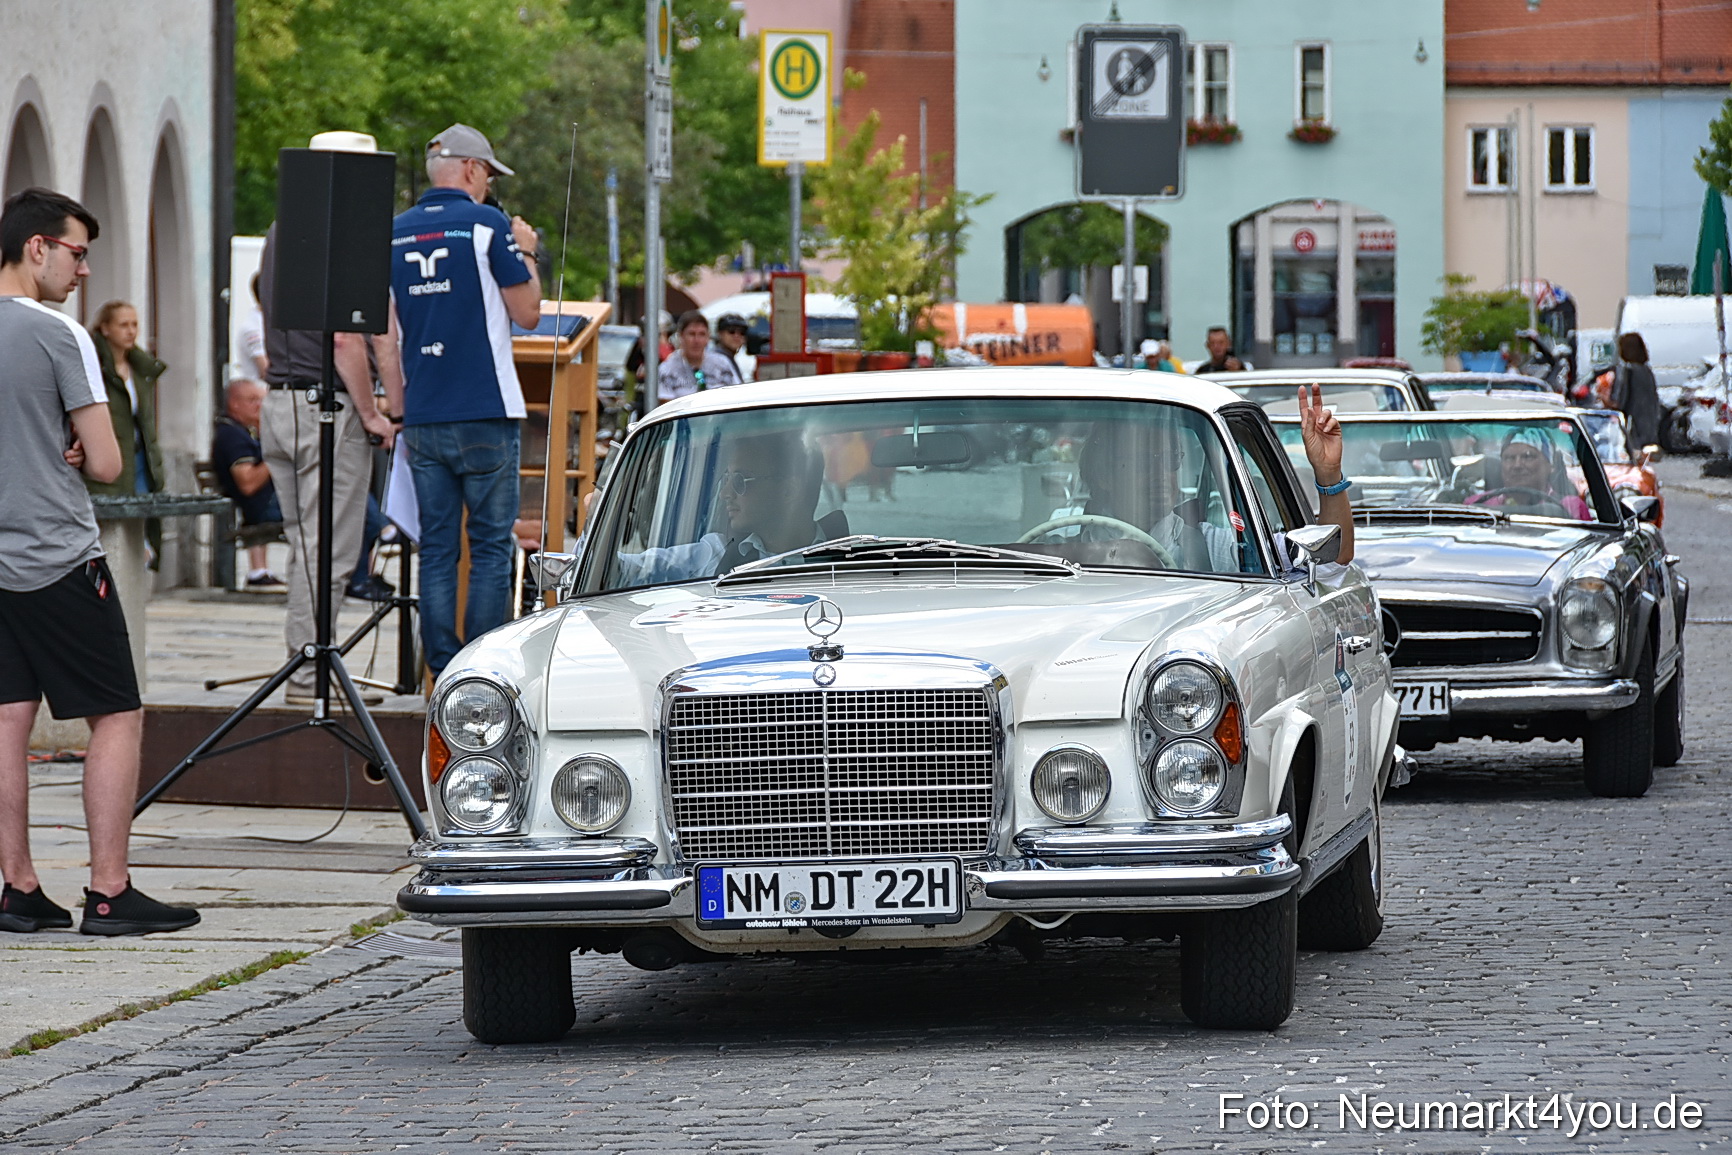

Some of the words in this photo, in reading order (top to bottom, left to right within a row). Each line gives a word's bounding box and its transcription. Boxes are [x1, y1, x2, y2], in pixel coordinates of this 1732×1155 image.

[784, 53, 806, 85] H
[408, 278, 451, 296] randstad
[726, 872, 780, 913] NM
[810, 869, 863, 910] DT
[874, 867, 951, 909] 22H
[708, 900, 717, 912] D
[745, 919, 780, 928] autohaus
[781, 918, 808, 927] löhlein
[811, 917, 861, 927] Mercedes-Benz
[863, 917, 870, 925] in
[871, 916, 912, 925] Wendelstein
